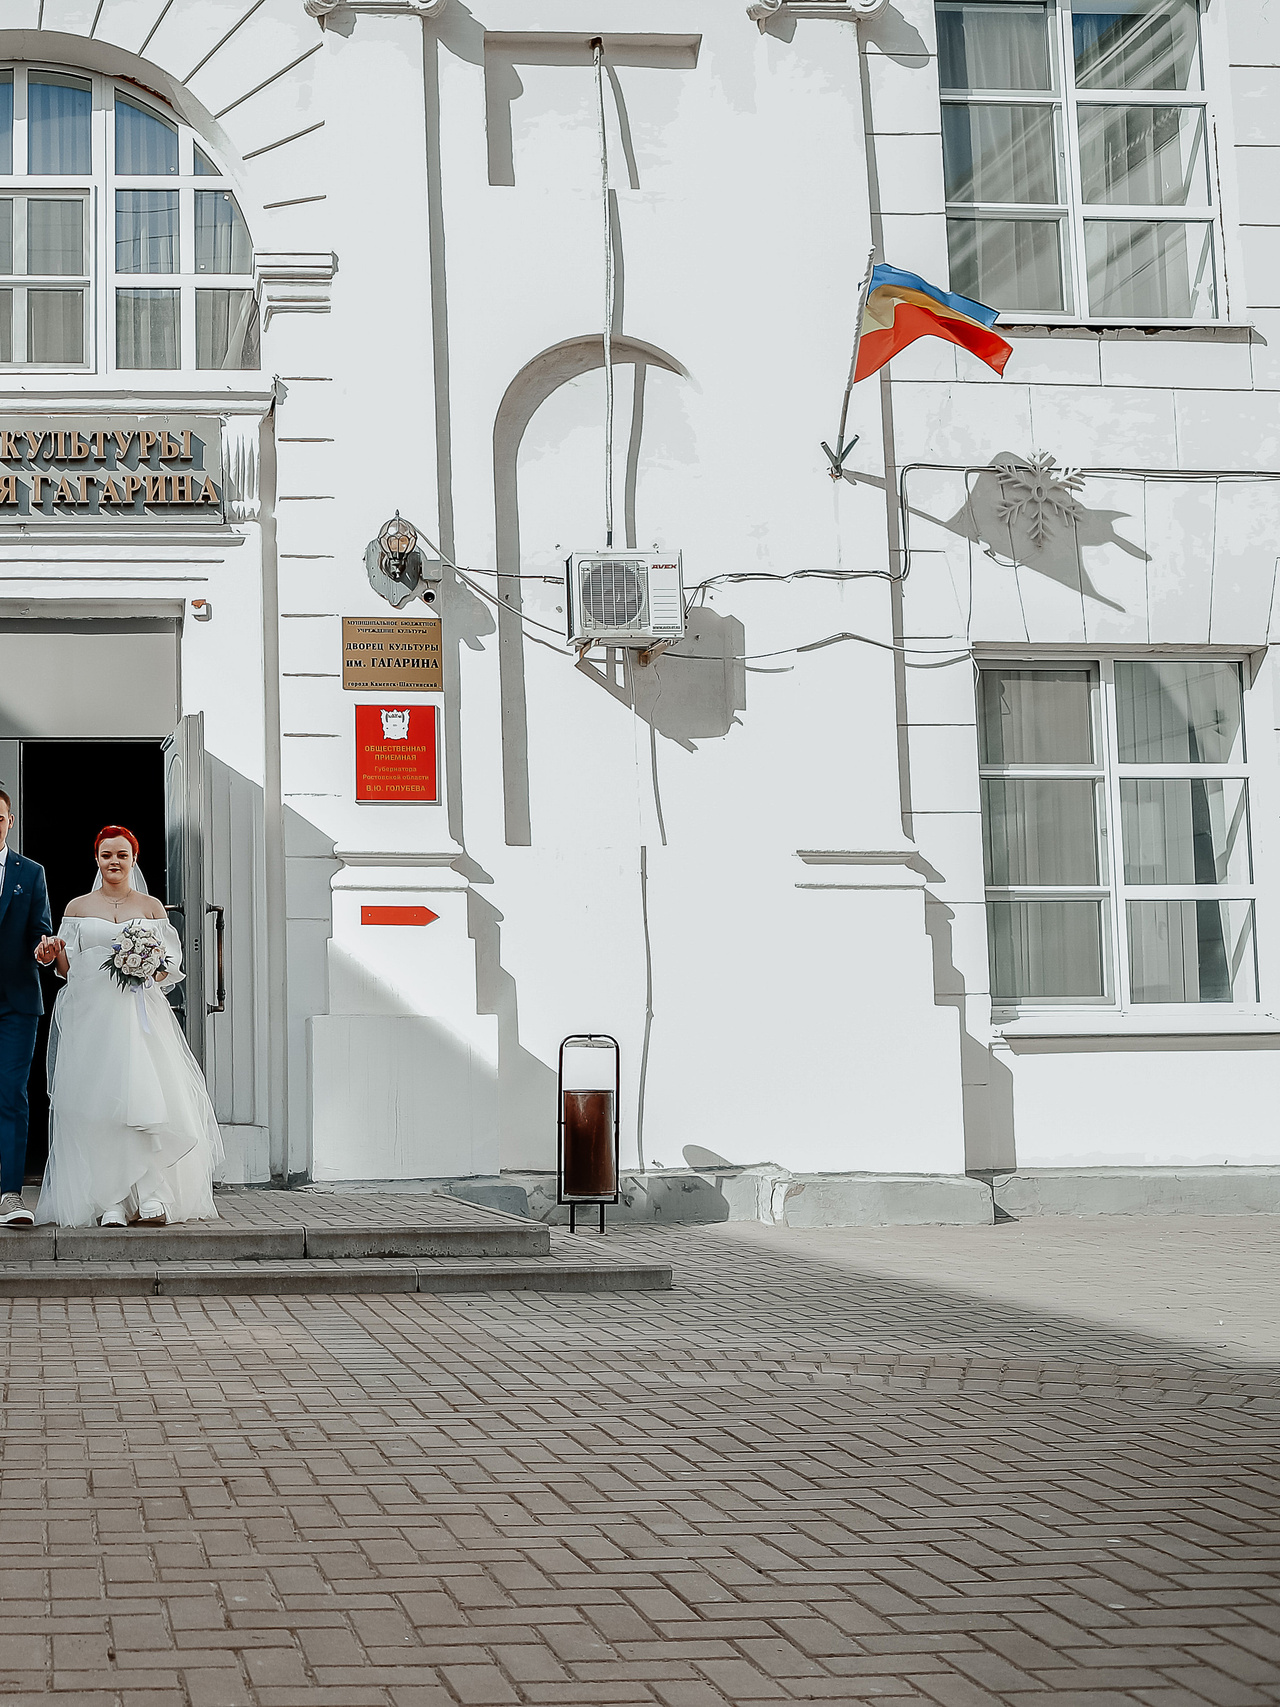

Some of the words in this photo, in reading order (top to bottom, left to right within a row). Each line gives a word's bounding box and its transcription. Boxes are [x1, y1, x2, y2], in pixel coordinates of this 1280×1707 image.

[31, 475, 221, 506] ГАГАРИНА
[345, 643, 384, 651] ДВОРЕЦ
[389, 643, 439, 652] КУЛЬТУРЫ
[371, 658, 439, 669] ГАГАРИНА
[364, 745, 427, 753] ОБЩЕСТВЕННАЯ
